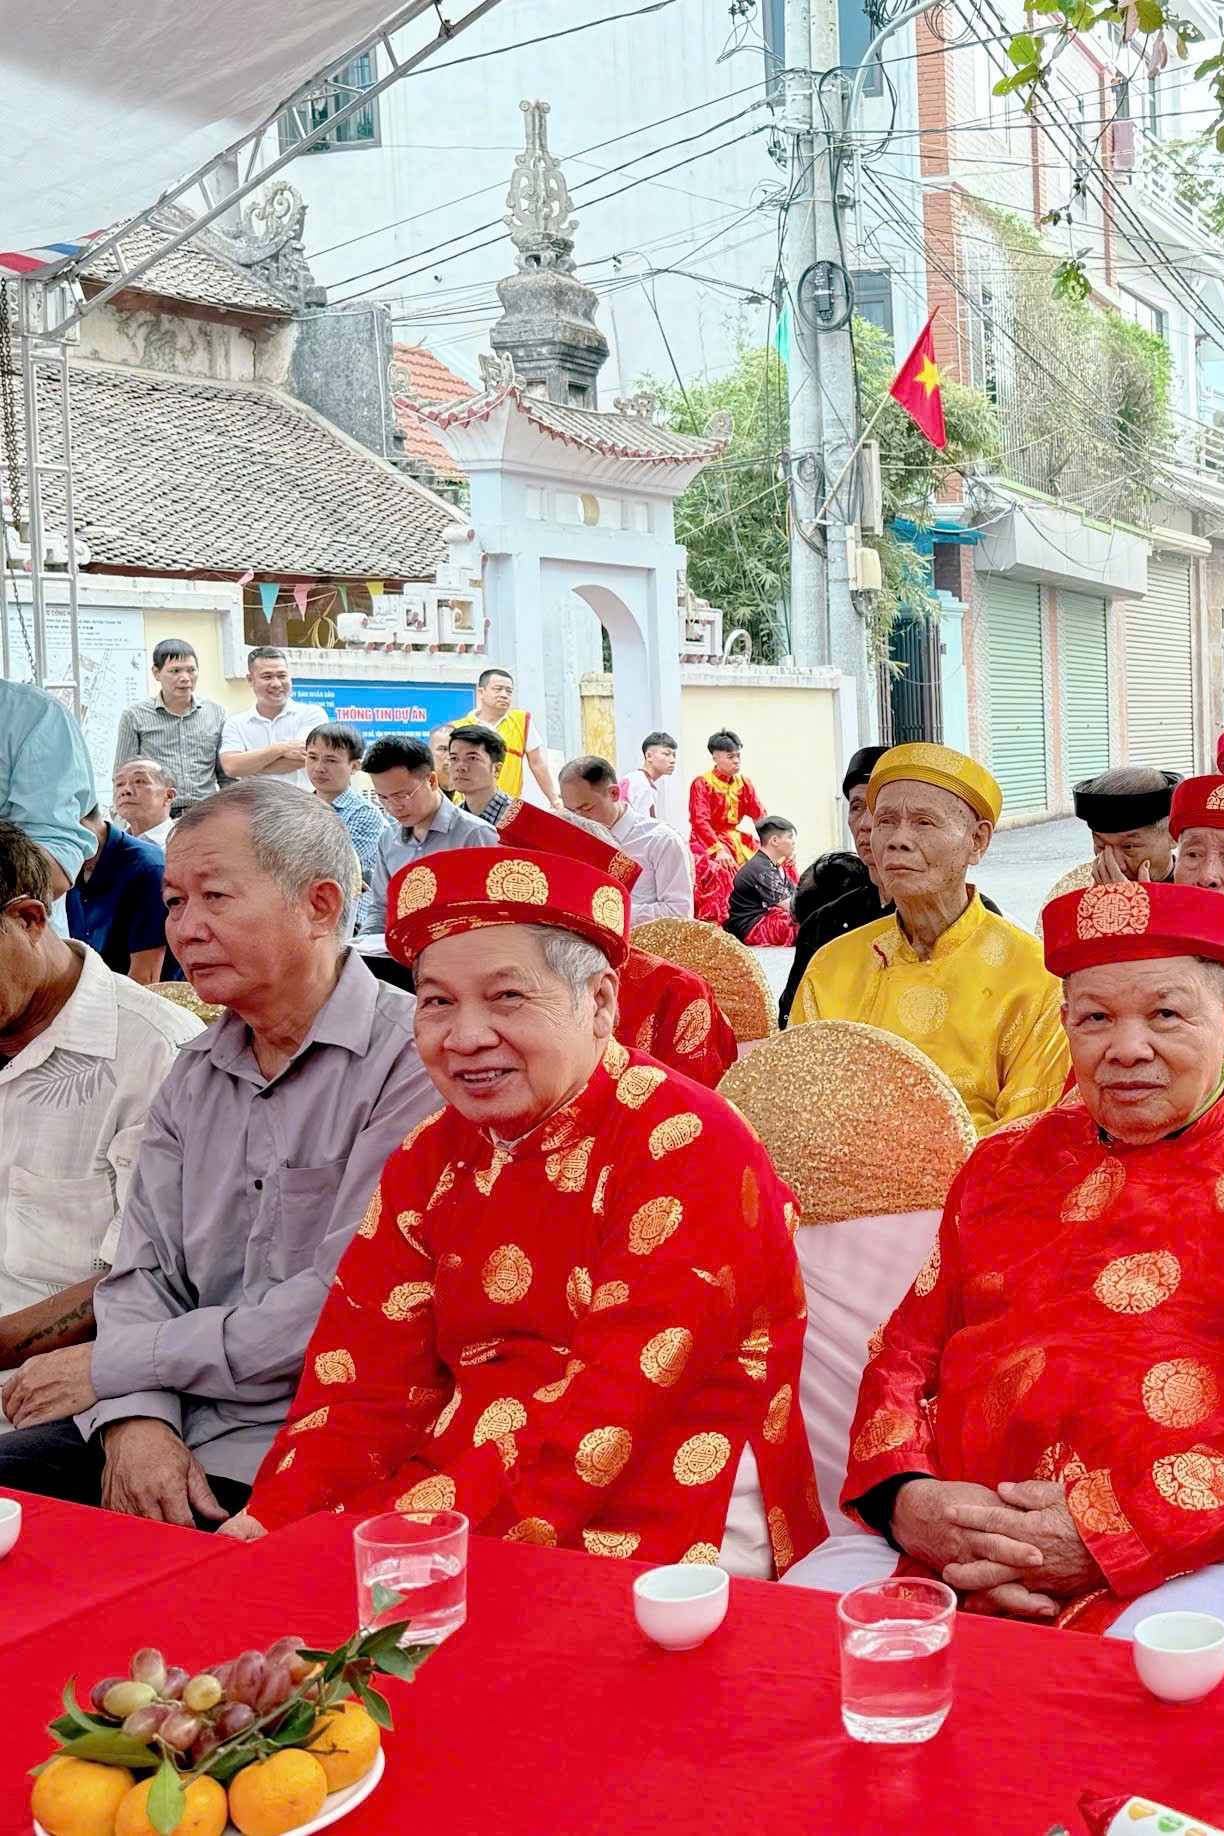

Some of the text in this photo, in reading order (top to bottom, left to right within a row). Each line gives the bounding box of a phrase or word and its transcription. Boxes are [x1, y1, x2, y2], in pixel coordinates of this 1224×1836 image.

[336, 704, 373, 722] THÔNG
[374, 707, 393, 722] TIN
[411, 706, 427, 722] ÁN
